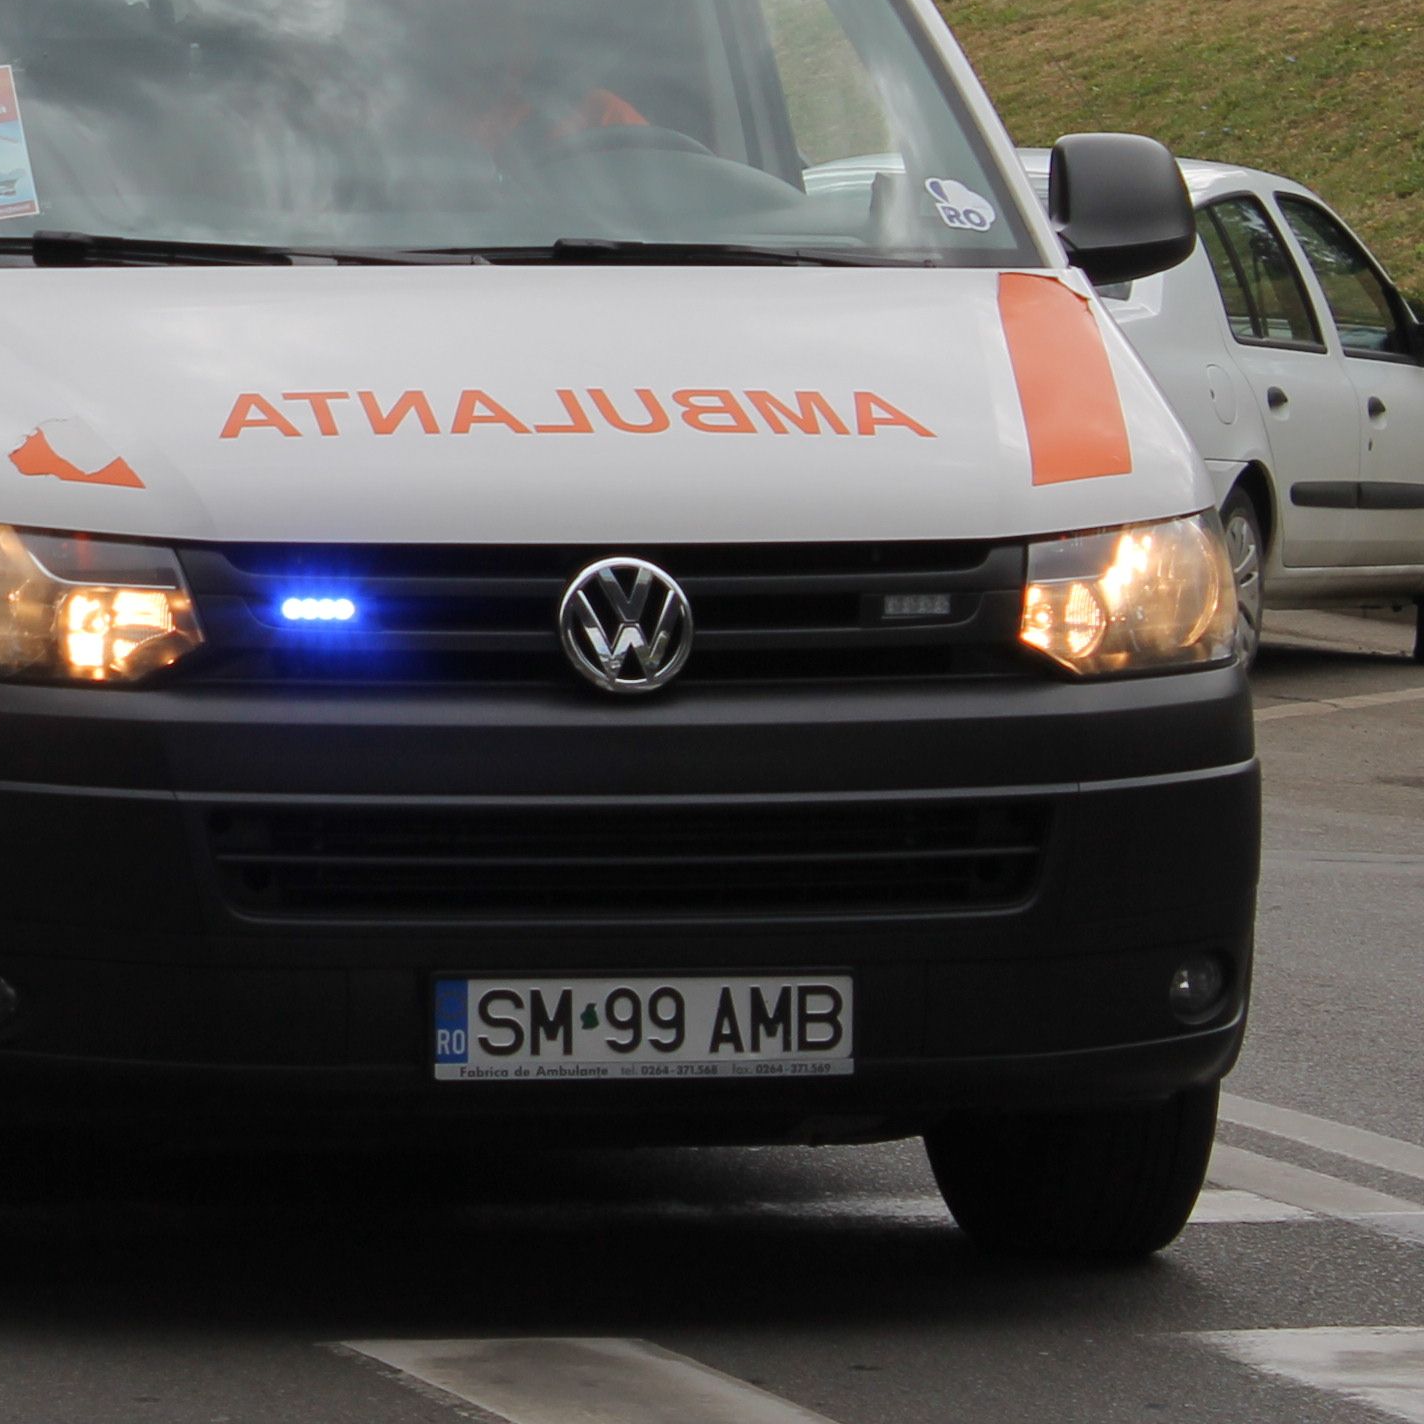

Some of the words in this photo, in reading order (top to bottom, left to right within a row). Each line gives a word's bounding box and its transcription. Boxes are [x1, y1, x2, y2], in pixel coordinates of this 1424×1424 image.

[940, 205, 988, 229] RO
[561, 558, 692, 692] VW
[478, 988, 573, 1056] SM
[605, 986, 685, 1054] 99
[709, 984, 843, 1054] AMB
[436, 1029, 466, 1055] RO
[460, 1066, 509, 1077] Fabrica
[514, 1065, 531, 1077] de
